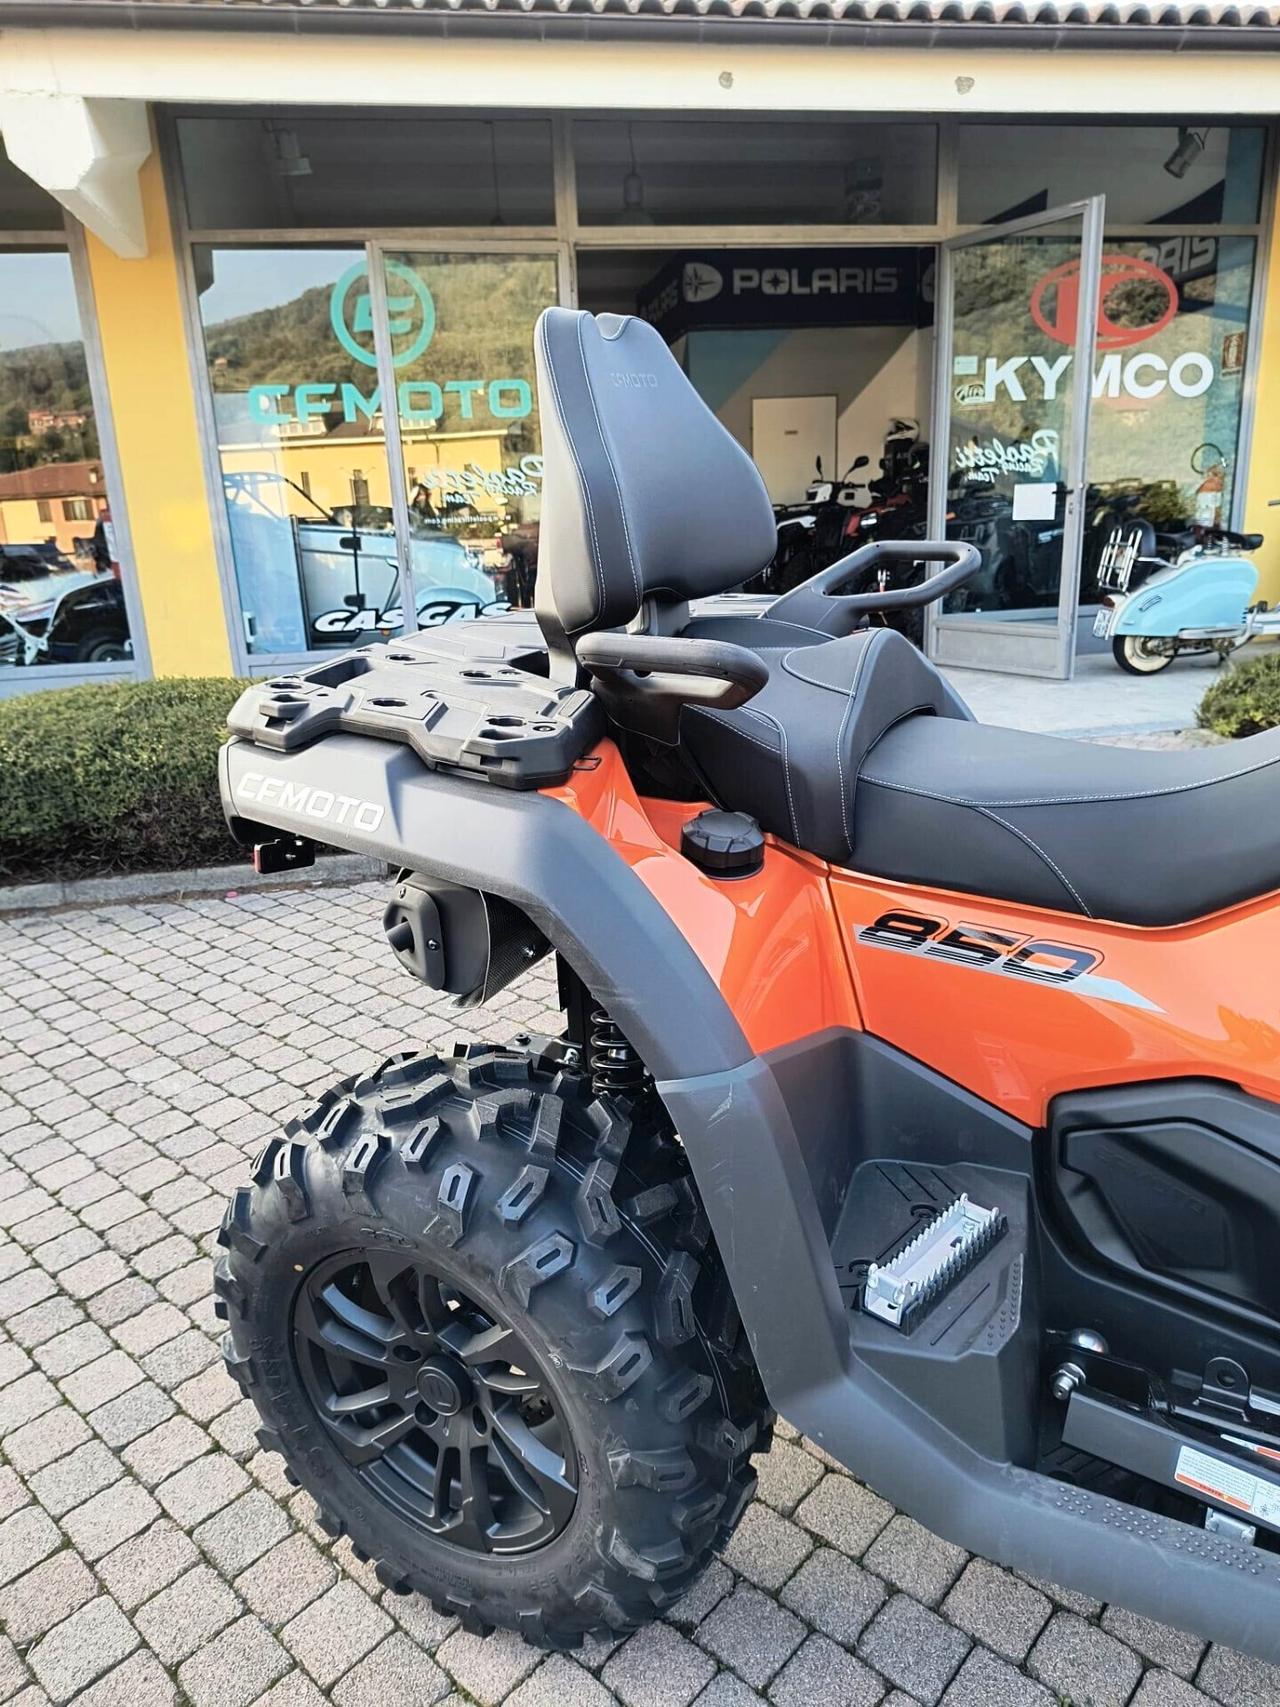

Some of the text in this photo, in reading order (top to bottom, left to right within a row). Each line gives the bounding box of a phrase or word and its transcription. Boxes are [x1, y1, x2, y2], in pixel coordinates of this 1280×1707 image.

[733, 267, 898, 295] POLARIS
[985, 352, 1214, 402] KYMCO
[248, 379, 533, 424] CFMOTO
[314, 601, 512, 633] GASGAS
[236, 772, 385, 833] CFMOTO
[858, 908, 1105, 984] 850
